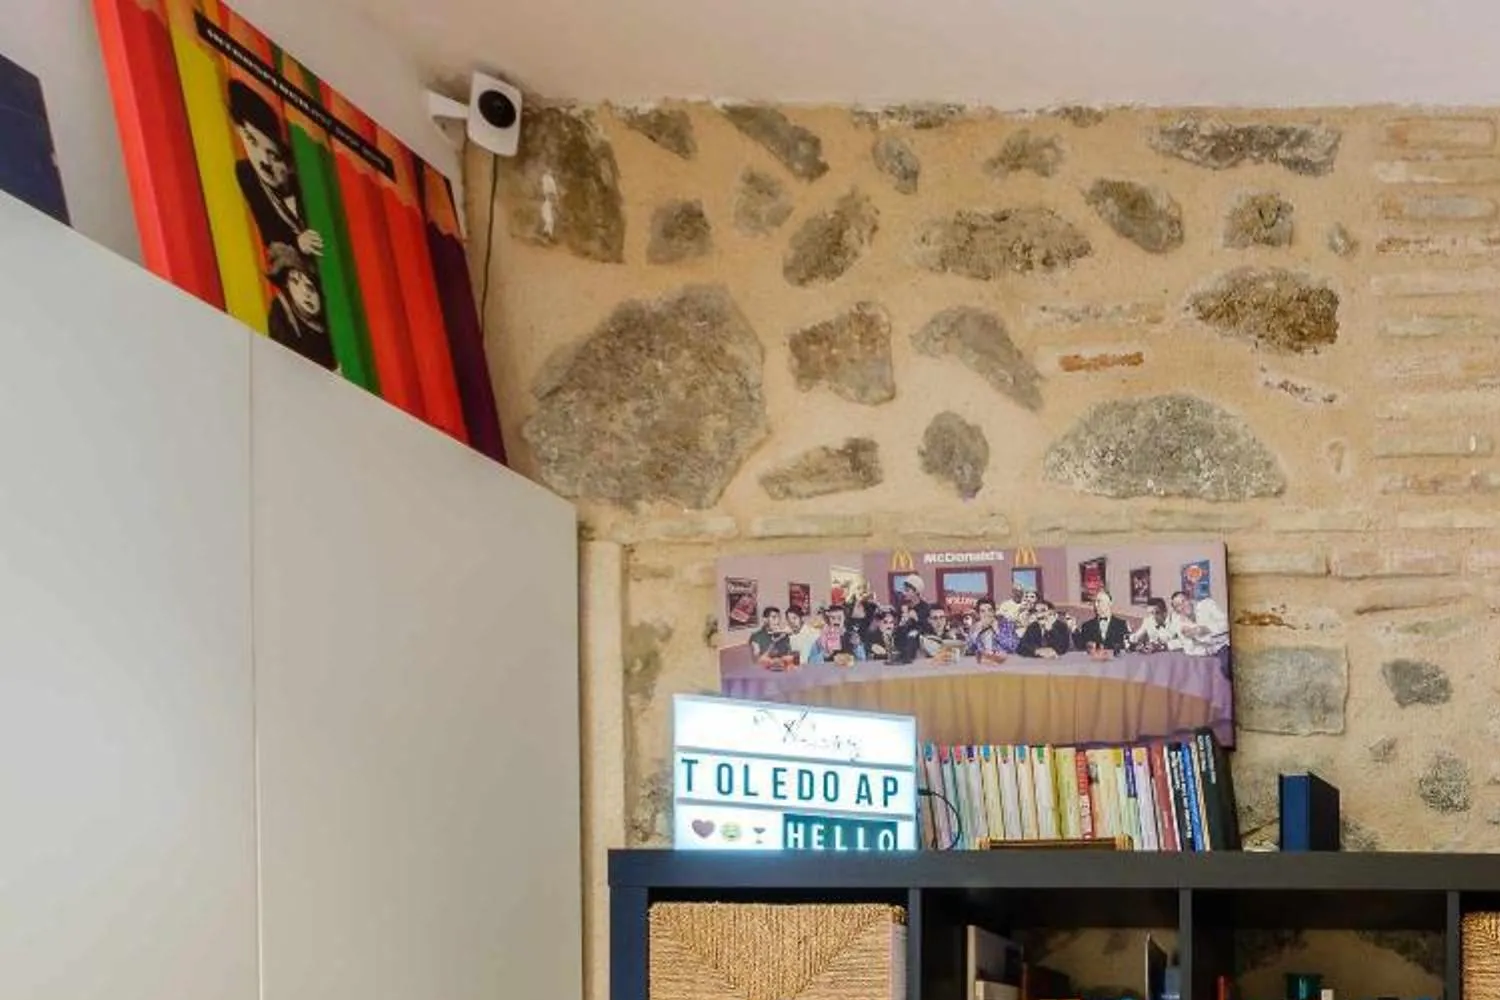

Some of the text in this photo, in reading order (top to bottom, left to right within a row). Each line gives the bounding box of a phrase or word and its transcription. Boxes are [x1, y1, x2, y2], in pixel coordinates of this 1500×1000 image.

[923, 550, 1005, 564] McDonald's
[681, 758, 899, 808] TOLEDO AP
[787, 821, 895, 850] HELLO
